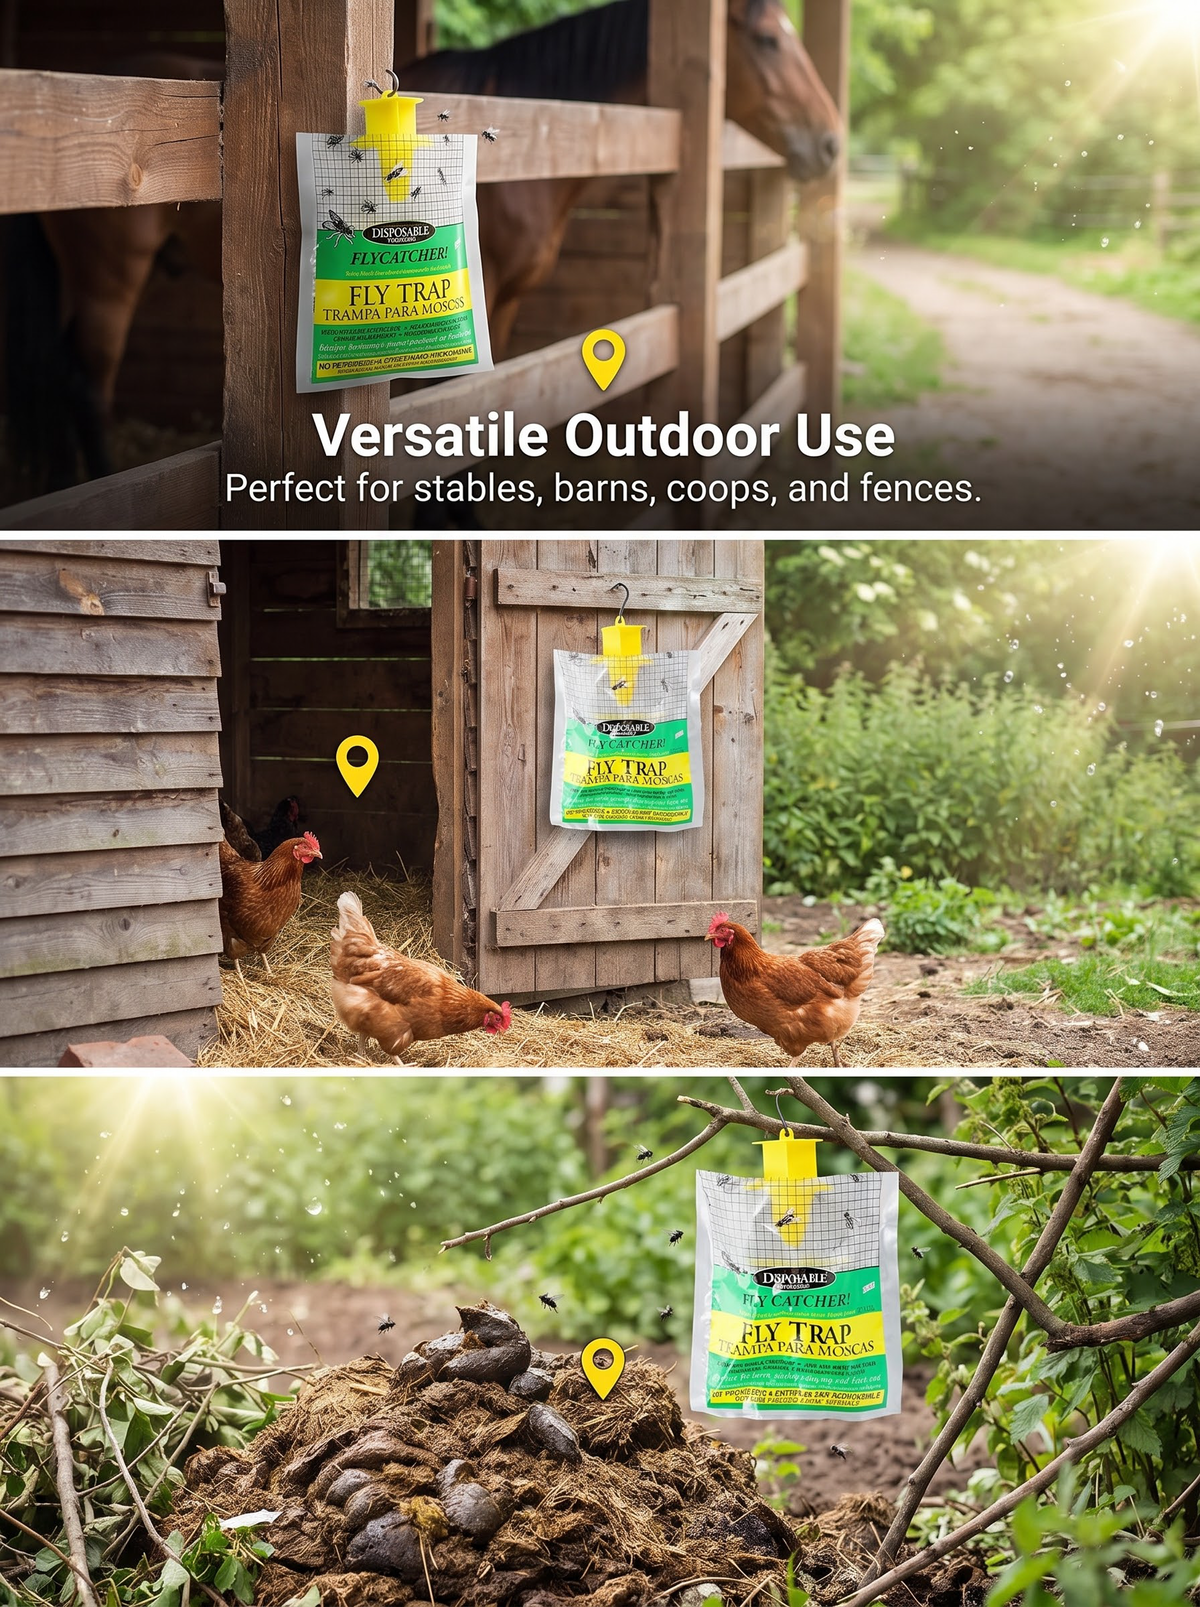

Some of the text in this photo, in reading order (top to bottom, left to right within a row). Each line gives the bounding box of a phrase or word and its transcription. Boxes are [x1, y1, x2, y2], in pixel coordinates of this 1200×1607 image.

[372, 225, 430, 239] DISPOSABLE
[351, 246, 448, 266] FLYCATCHER!
[349, 278, 451, 307] FLY TRAP
[322, 307, 381, 321] TRAMPA
[384, 304, 419, 319] PARA
[587, 758, 667, 776] FLY TRAP
[613, 774, 640, 784] PARA
[642, 772, 684, 785] MOSCAS
[771, 1293, 851, 1308] CATCHER!
[741, 1321, 852, 1345] FLY TRAP
[778, 1341, 814, 1355] PARA
[818, 1340, 875, 1357] MOSCAS
